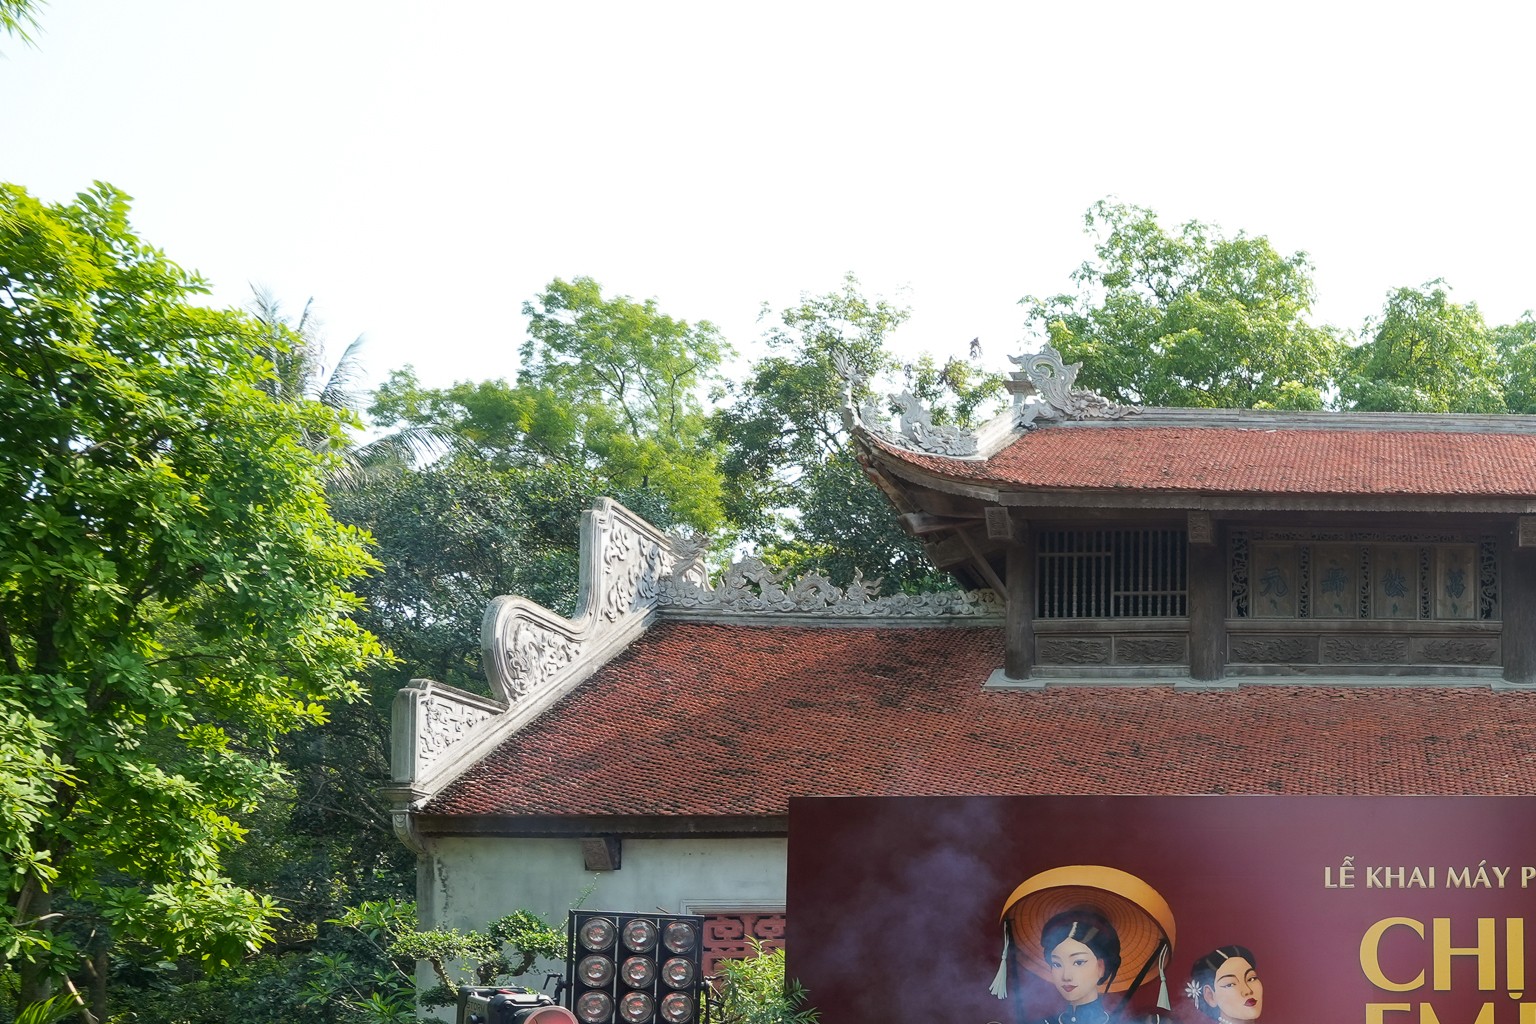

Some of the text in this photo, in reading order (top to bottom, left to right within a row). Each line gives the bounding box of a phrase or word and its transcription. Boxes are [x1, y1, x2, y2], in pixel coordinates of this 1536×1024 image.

[1324, 856, 1355, 888] LỄ
[1366, 866, 1434, 888] KHAI
[1446, 860, 1509, 888] MÁY
[1359, 917, 1525, 1000] CHỊ
